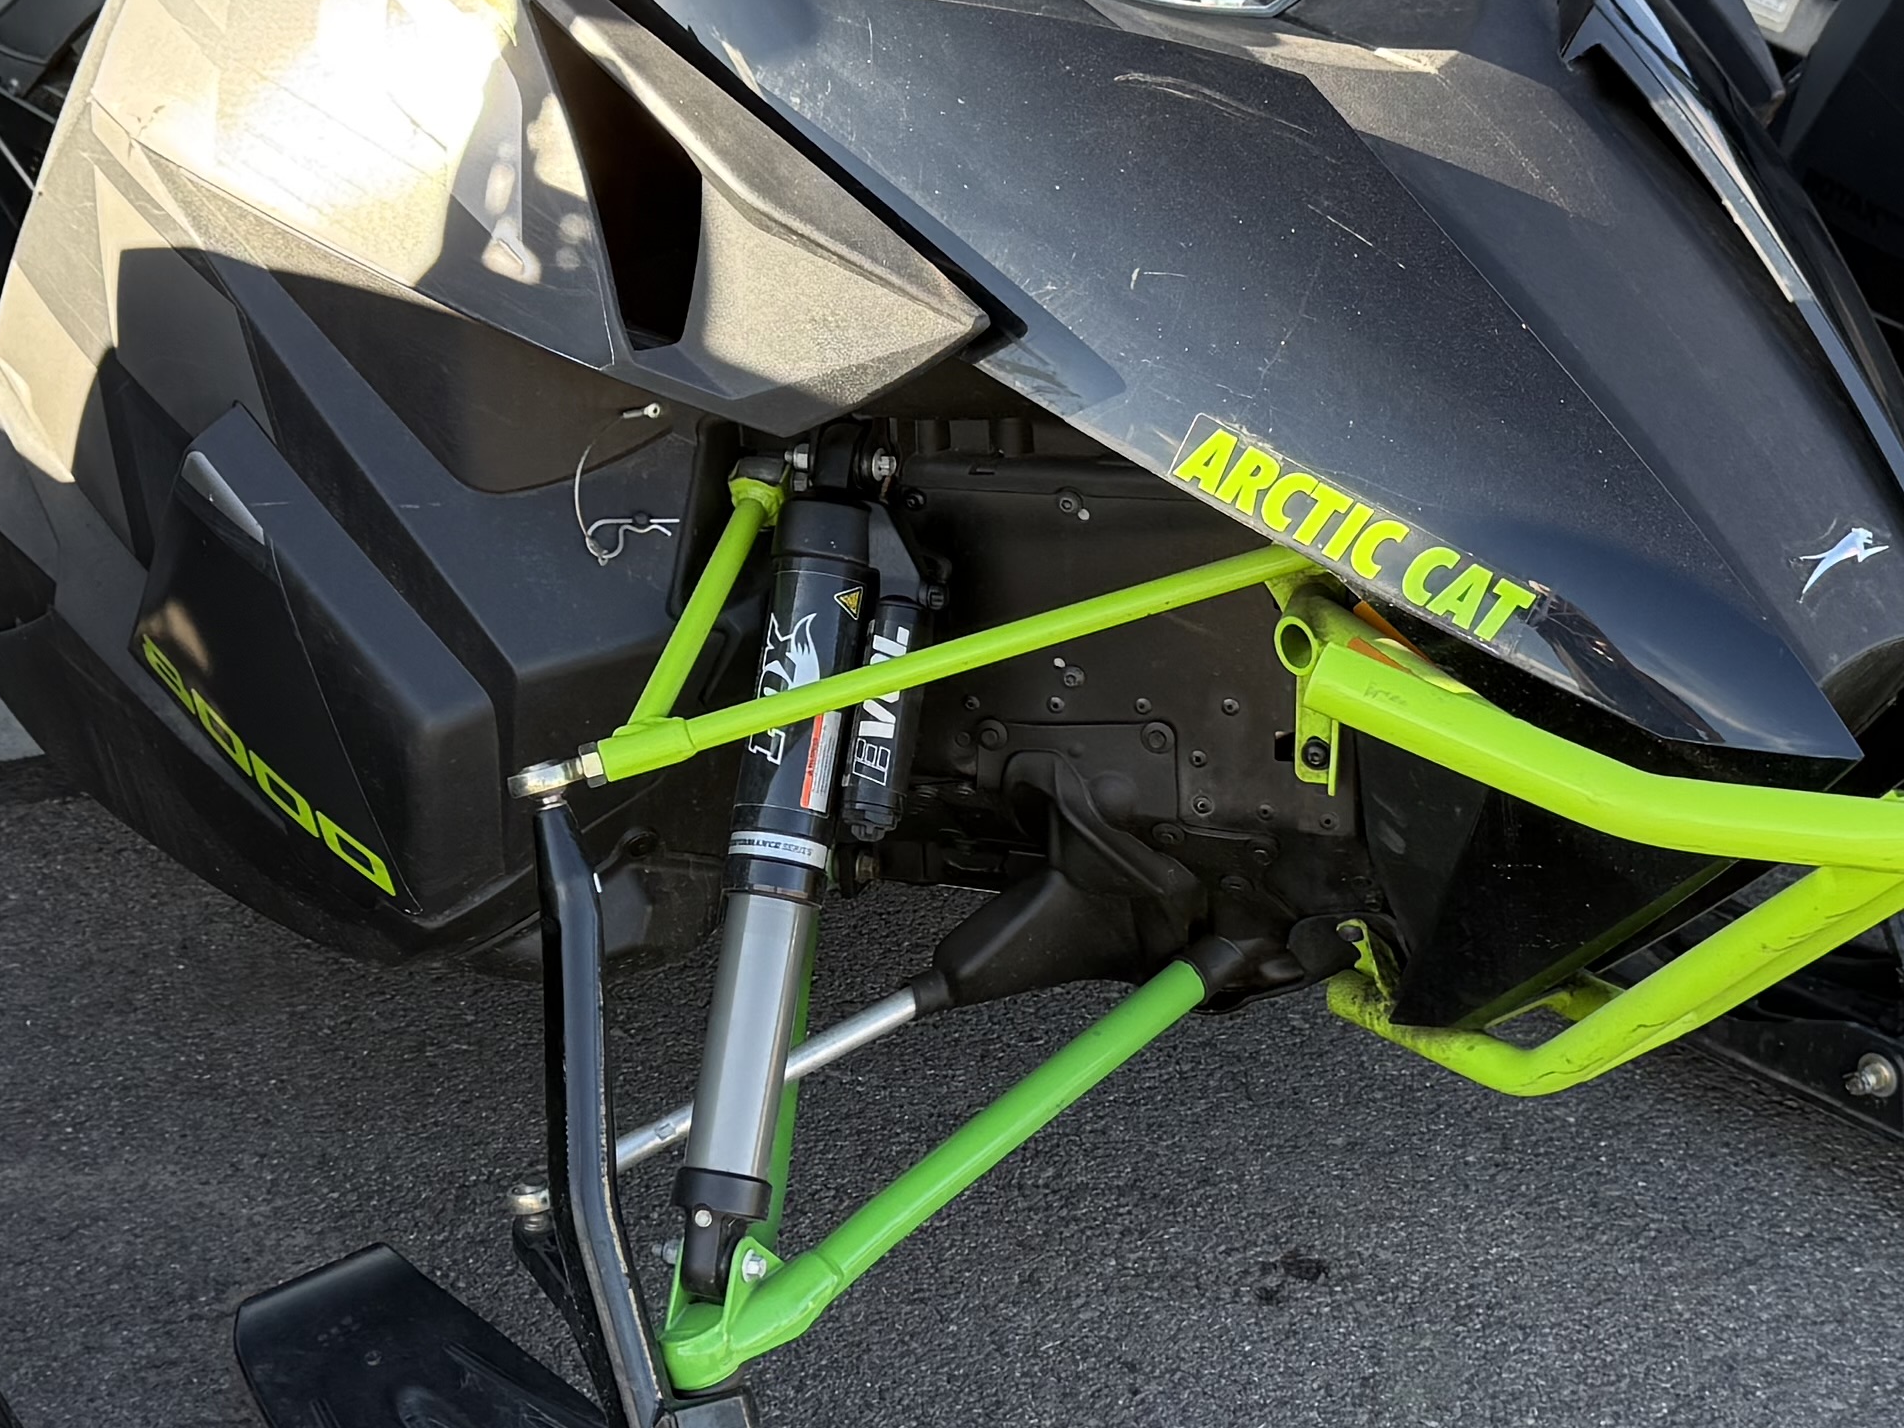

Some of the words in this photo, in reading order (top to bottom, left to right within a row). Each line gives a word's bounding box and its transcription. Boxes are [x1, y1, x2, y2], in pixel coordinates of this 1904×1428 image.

[1172, 427, 1411, 580] ARCTIC
[1401, 546, 1537, 642] CAT
[142, 632, 397, 898] 8000
